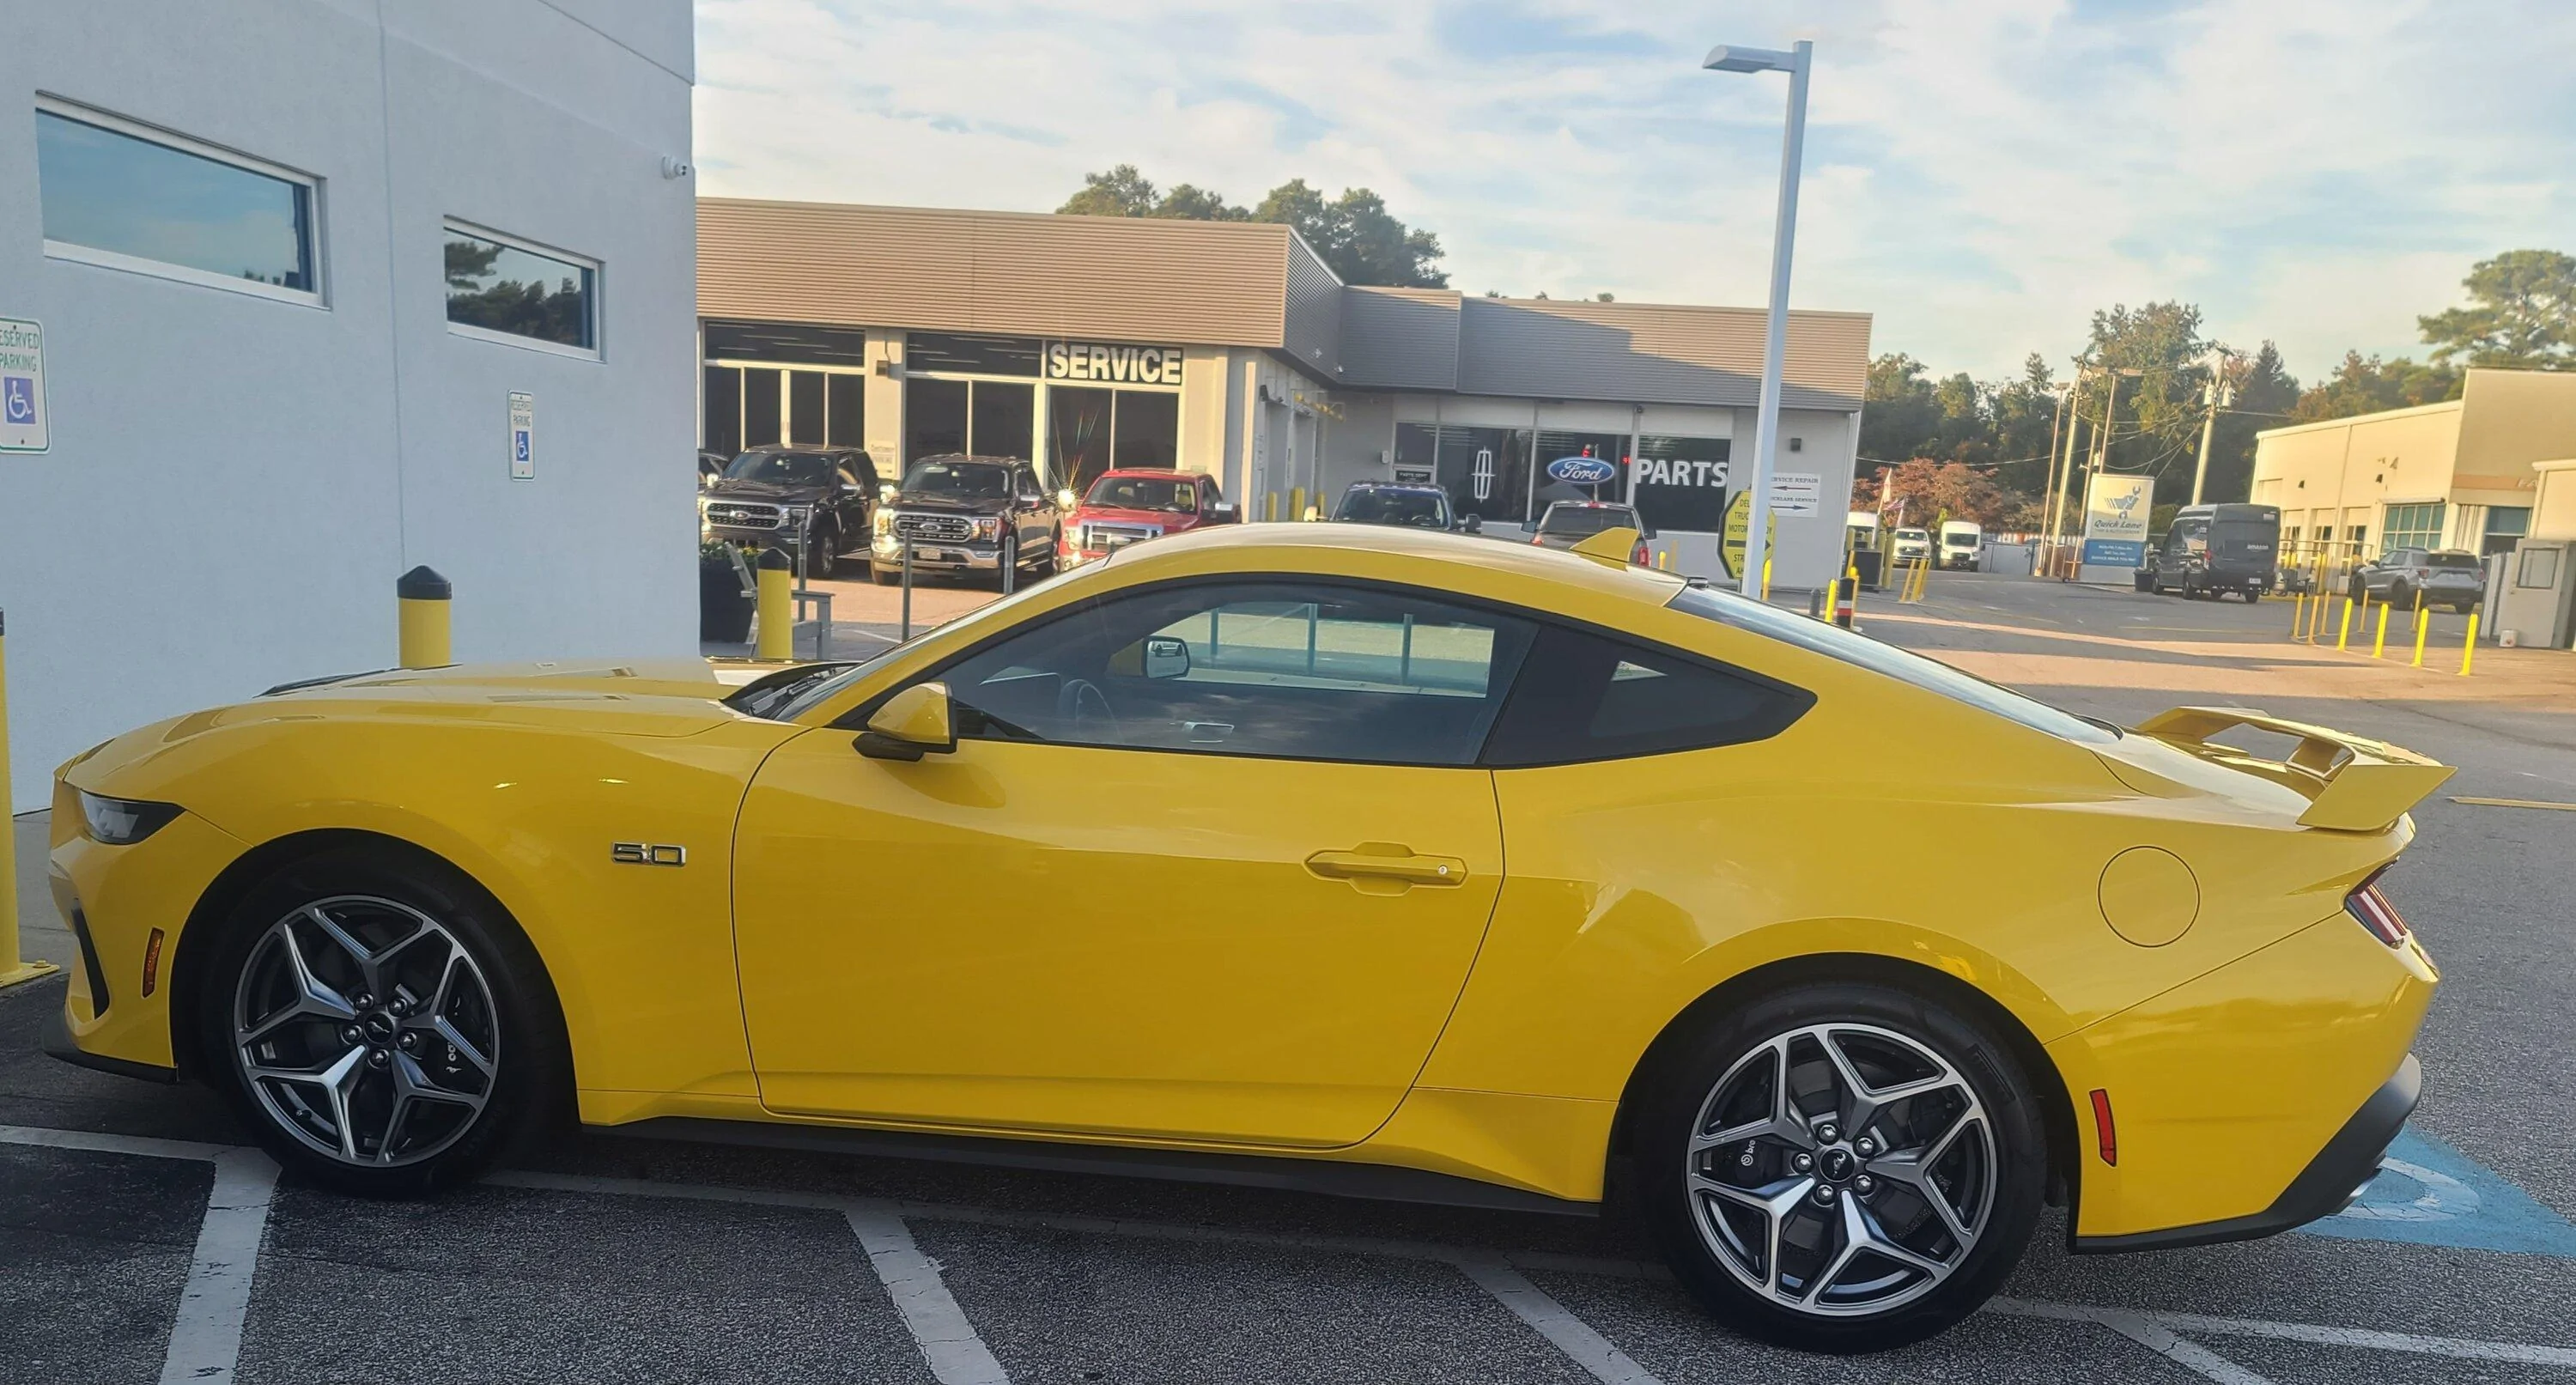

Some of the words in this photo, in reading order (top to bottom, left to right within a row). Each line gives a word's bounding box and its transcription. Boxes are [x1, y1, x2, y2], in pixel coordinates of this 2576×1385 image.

[0, 330, 39, 349] ESERVED
[1049, 344, 1182, 384] SERVICE
[1558, 460, 1602, 479] Ford
[1635, 459, 1728, 487] PARTS
[2094, 519, 2119, 528] Quick
